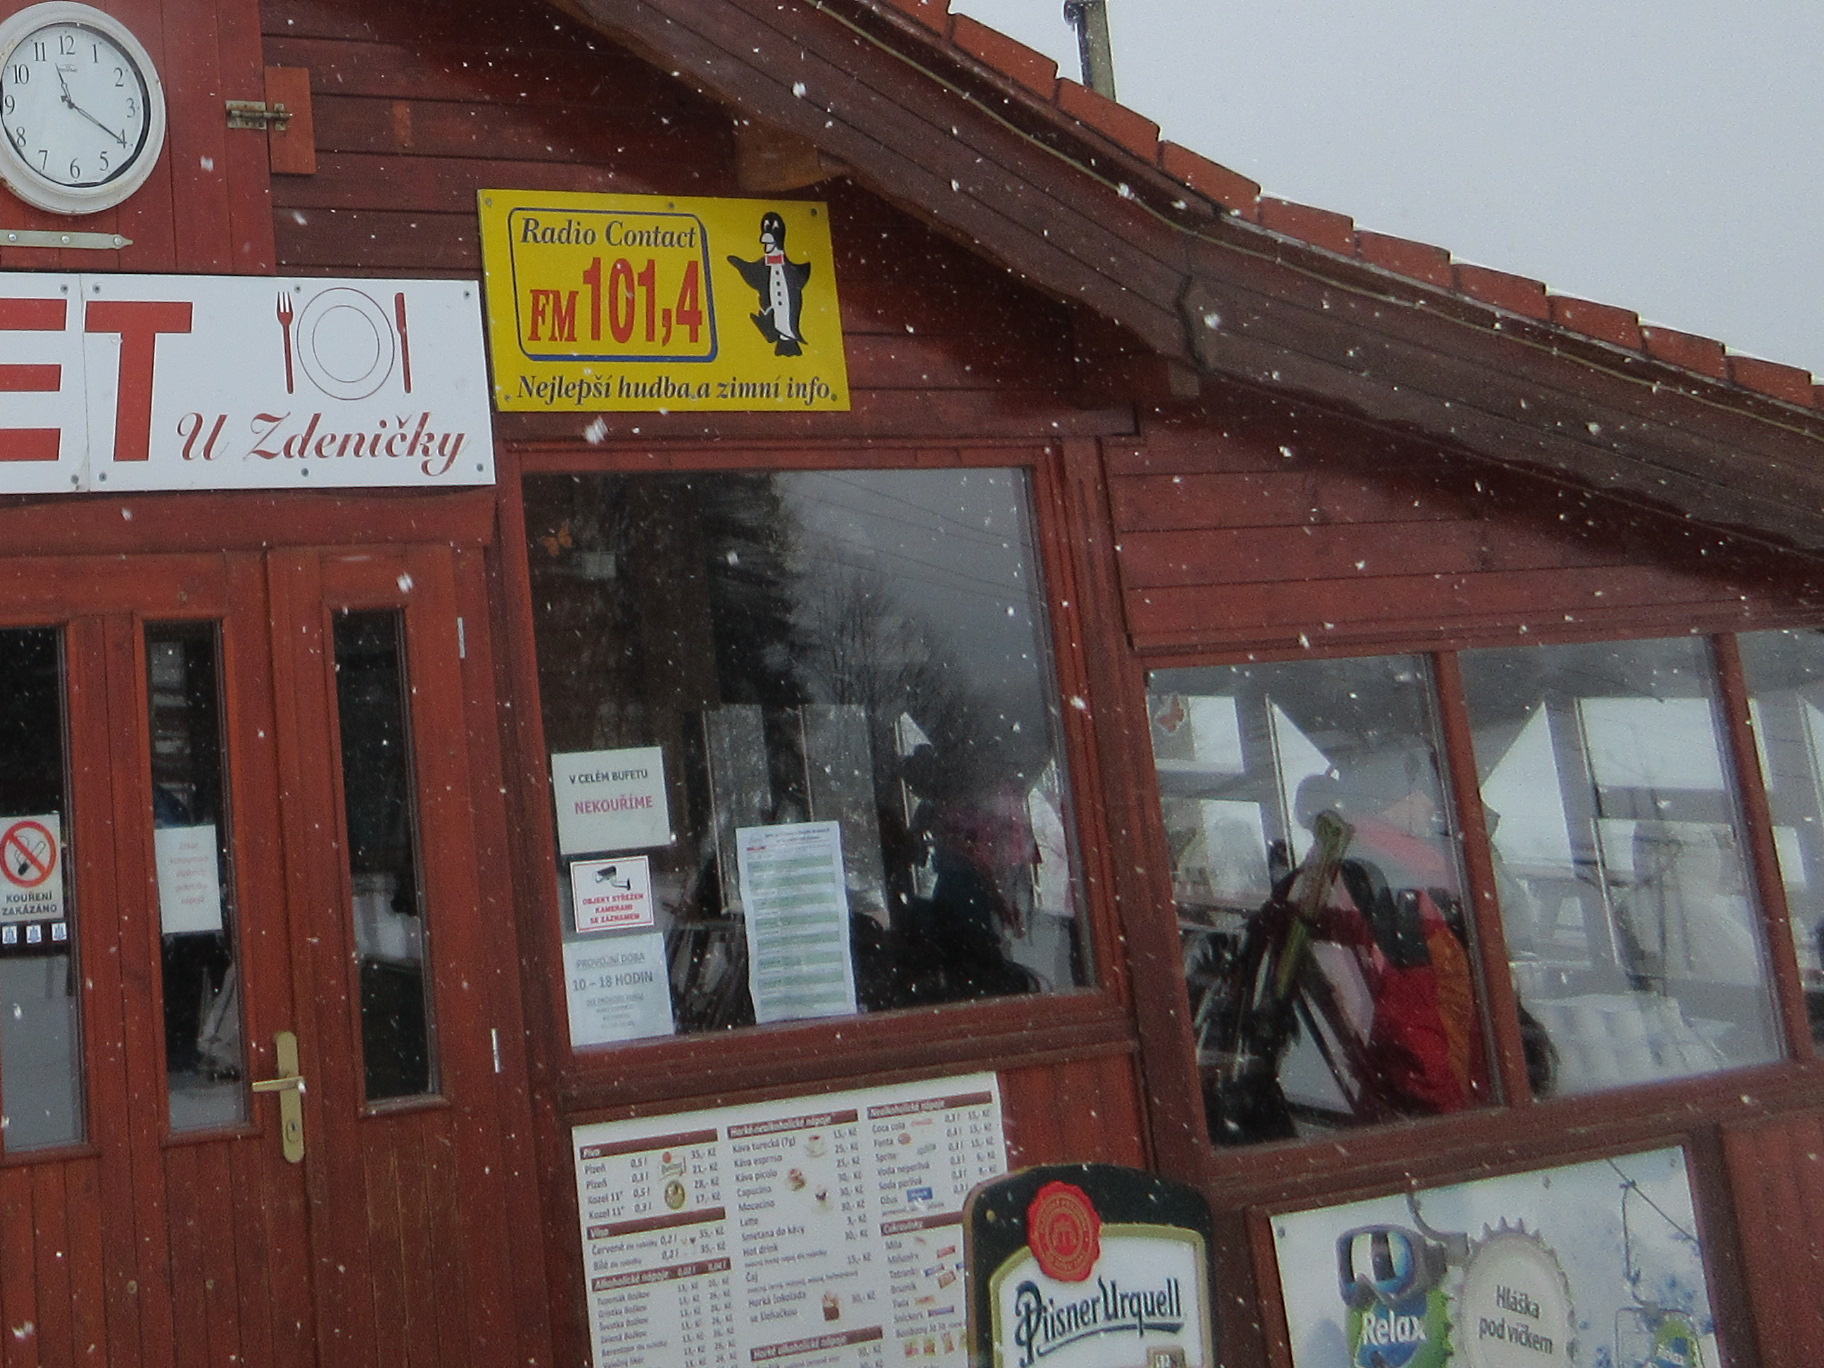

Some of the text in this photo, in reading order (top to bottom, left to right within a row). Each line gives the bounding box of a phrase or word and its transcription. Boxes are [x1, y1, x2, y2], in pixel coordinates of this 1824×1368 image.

[34, 42, 47, 61] 11
[59, 35, 76, 55] 12
[92, 44, 98, 63] 1
[13, 64, 30, 84] 10
[114, 68, 124, 87] 2
[5, 95, 15, 115] 9
[126, 98, 136, 118] 3
[16, 127, 26, 148] 8
[117, 129, 127, 148] 4
[38, 150, 48, 170] 7
[70, 158, 80, 179] 6
[100, 151, 109, 171] 5
[521, 217, 697, 248] Radio Contact
[528, 257, 702, 347] FM 101,4
[518, 375, 830, 405] Nejlepší hudba a zimní info
[177, 411, 471, 477] U Zdeničky
[569, 769, 648, 784] V CELÉM BUFETU
[575, 794, 653, 815] NEKOUŘÍME
[6, 890, 52, 904] KOUŘENÍ
[2, 904, 57, 916] ZAKÁZÁNO
[572, 971, 653, 991] 10 18 HODIN
[1495, 1285, 1541, 1320] Hláška
[1014, 1275, 1182, 1368] Pilsner Urquell
[1360, 1310, 1427, 1348] Relax
[1479, 1316, 1507, 1341] pod
